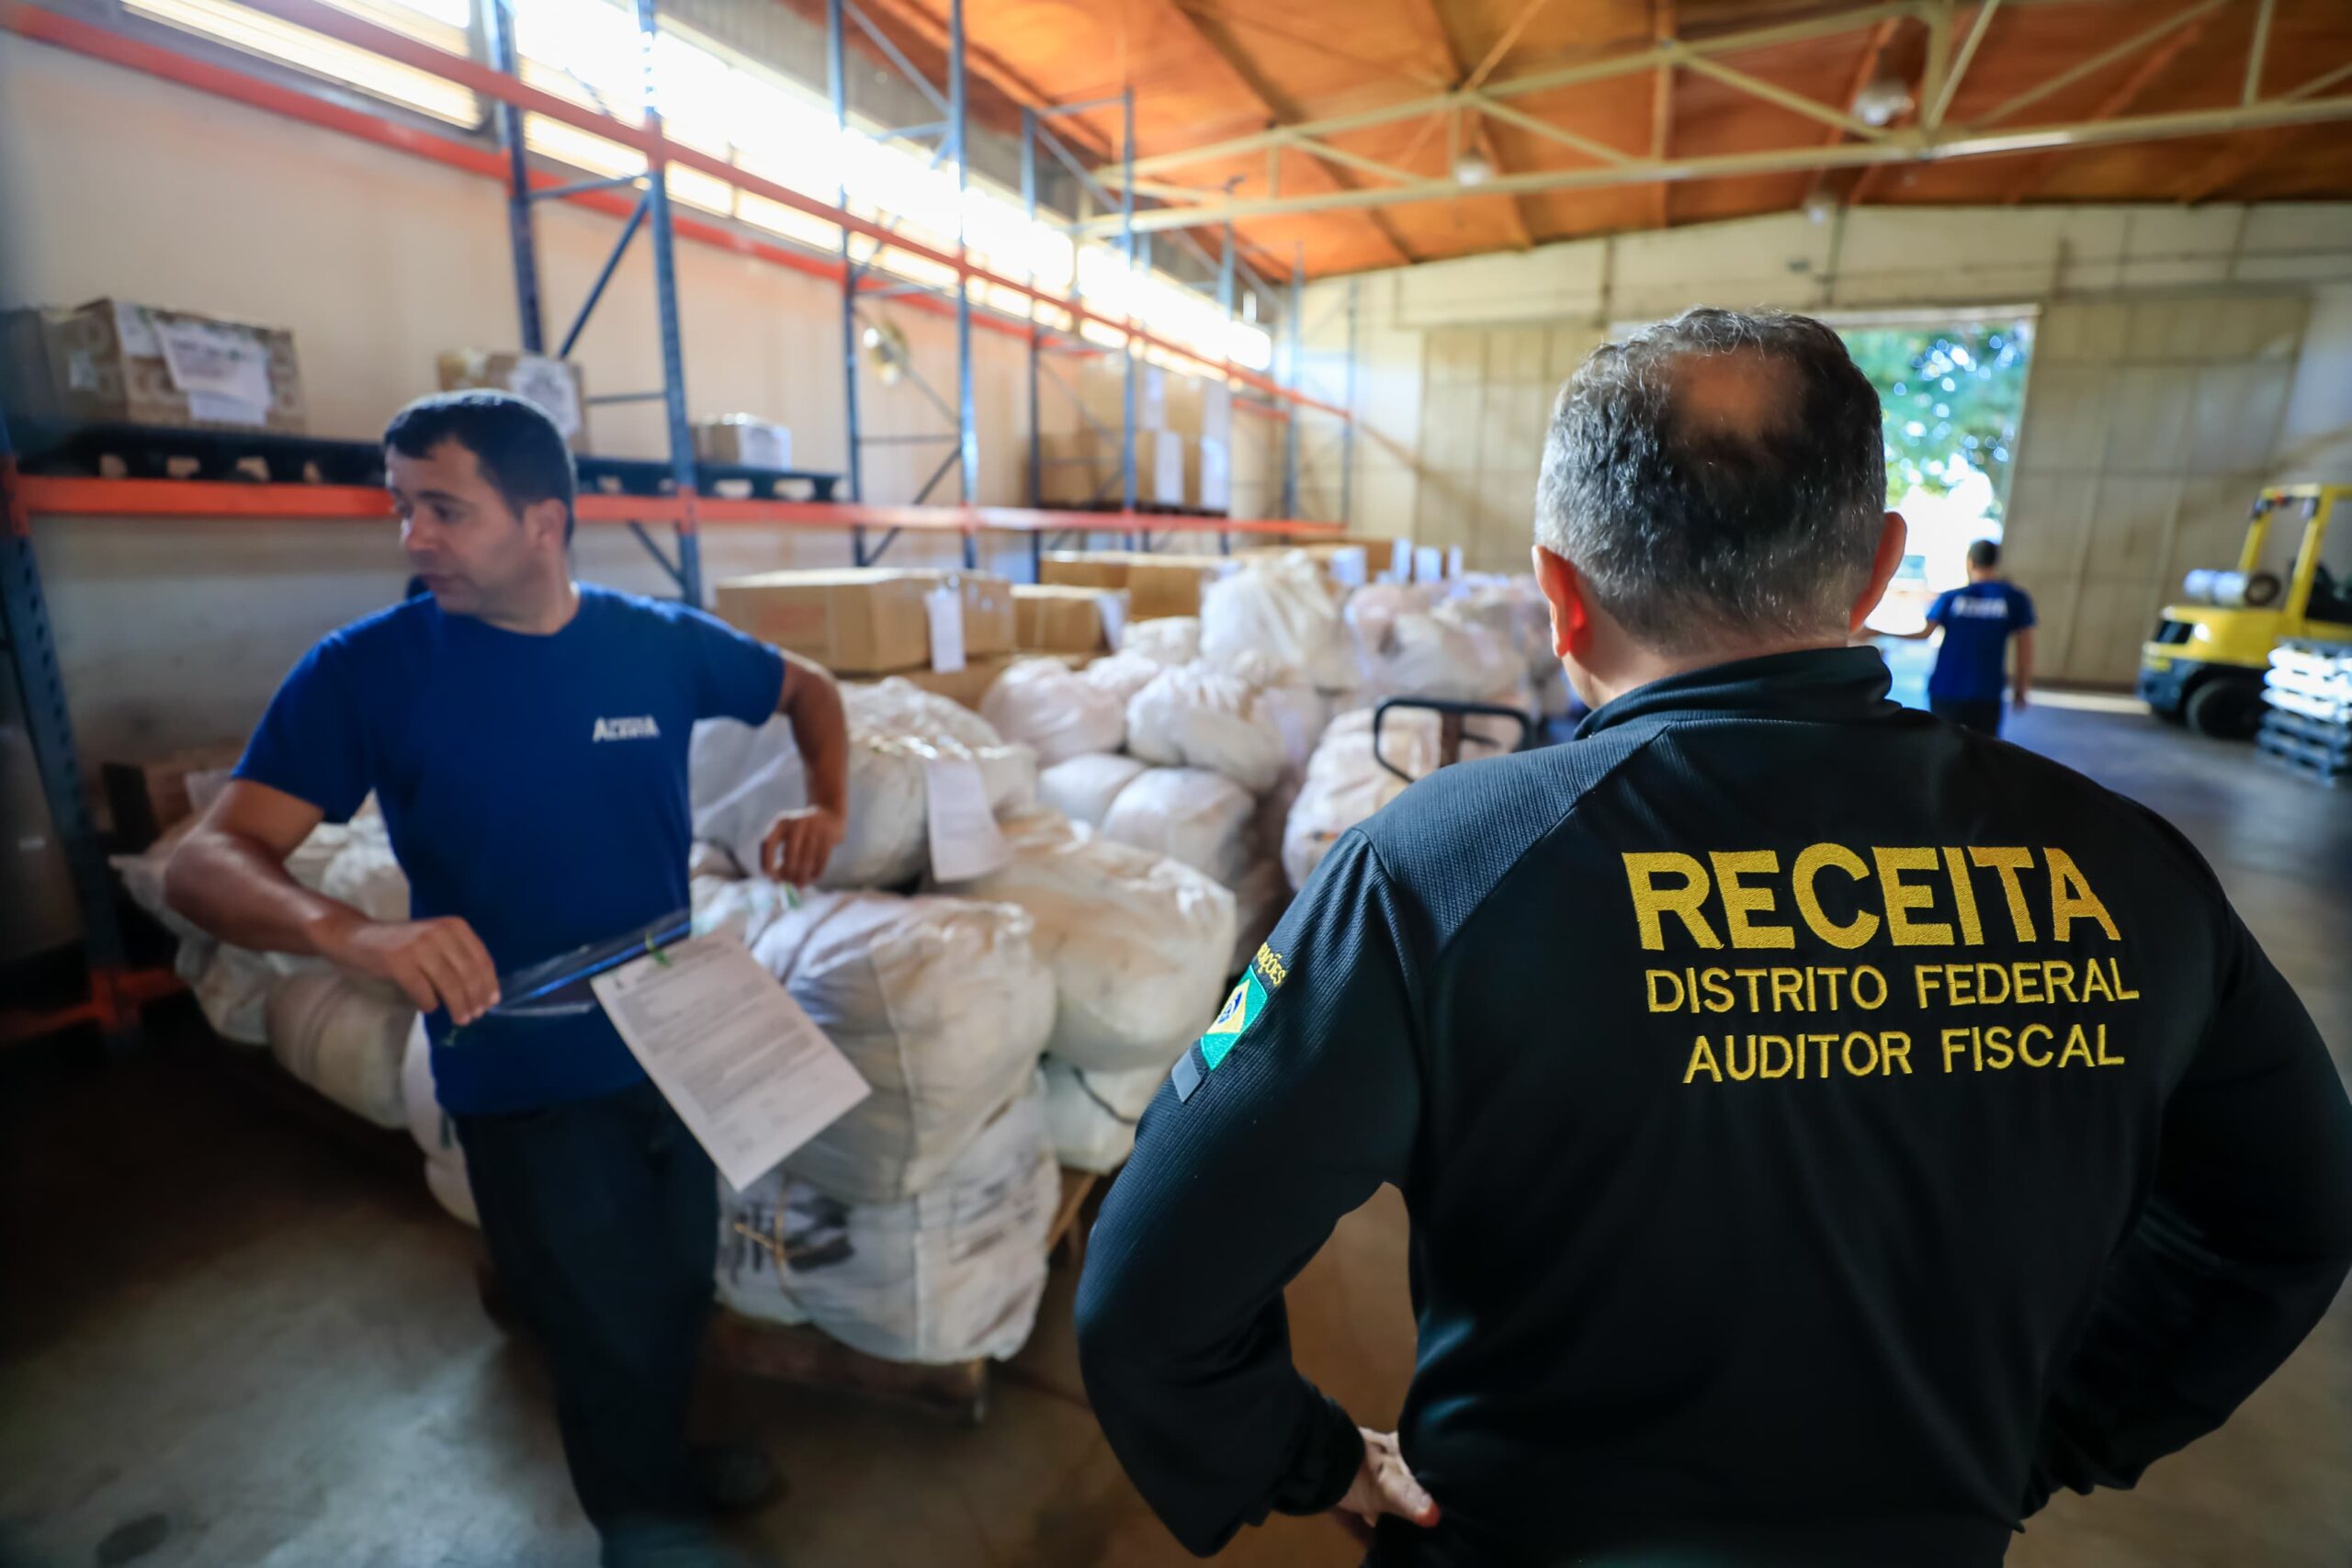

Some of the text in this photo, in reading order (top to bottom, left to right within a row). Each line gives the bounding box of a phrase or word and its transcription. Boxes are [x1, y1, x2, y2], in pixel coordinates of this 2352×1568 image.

[1622, 842, 2120, 951] RECEITA
[1645, 957, 2140, 1013] DISTRITO FEDERAL
[1683, 1023, 2125, 1083] AUDITOR FISCAL
